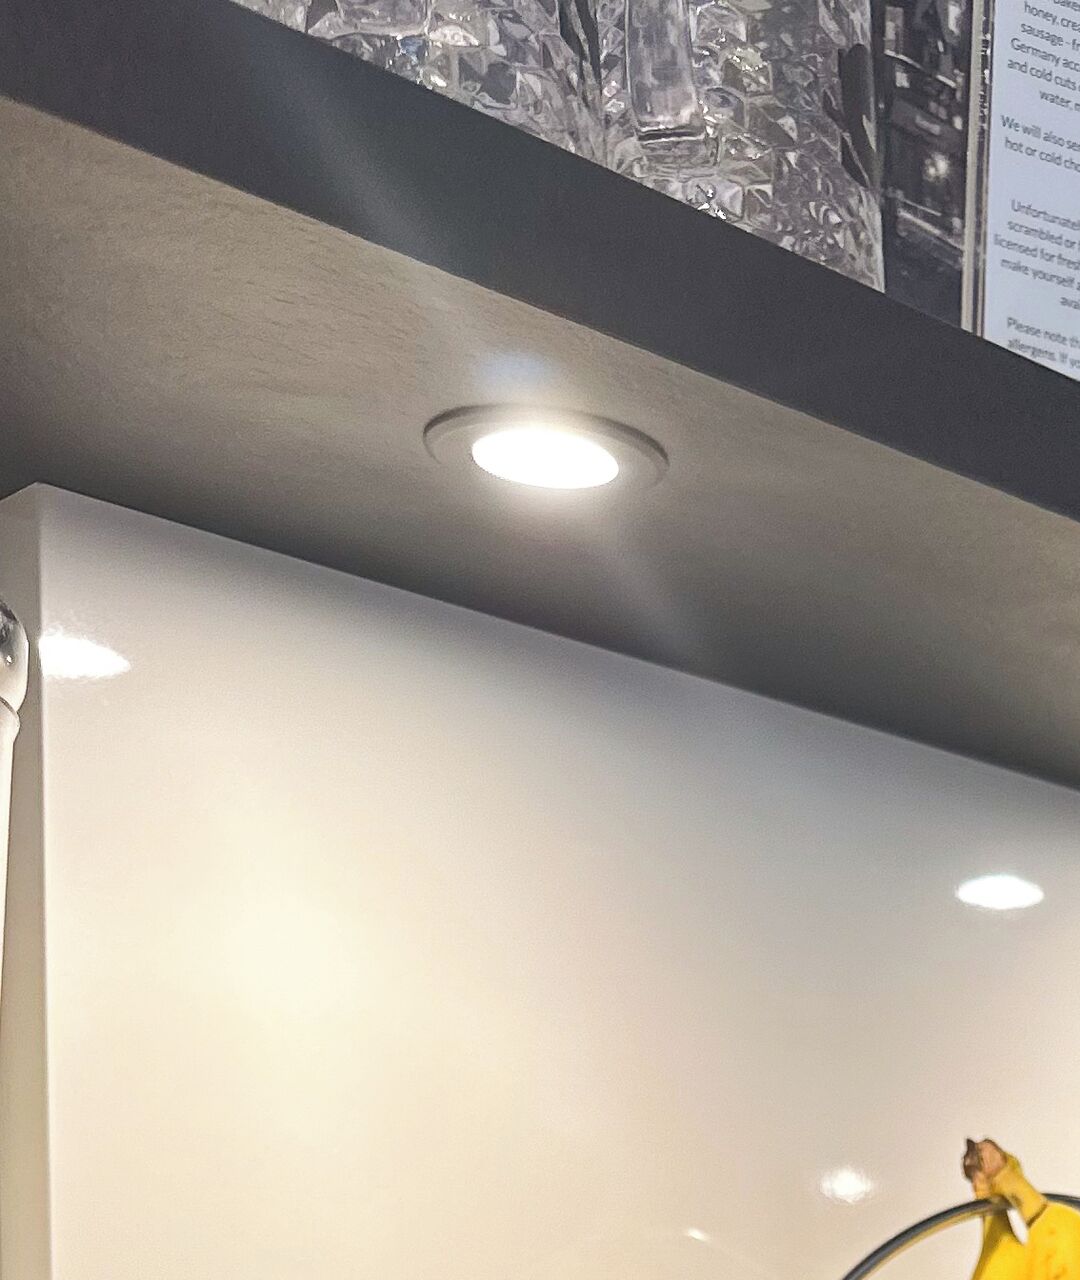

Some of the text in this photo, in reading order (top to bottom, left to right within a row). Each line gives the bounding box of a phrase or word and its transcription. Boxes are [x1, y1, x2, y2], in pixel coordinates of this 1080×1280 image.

[1024, 2, 1058, 27] honey,
[1021, 24, 1063, 47] sausage
[1011, 36, 1059, 68] Germany
[1007, 59, 1027, 74] and
[1029, 67, 1052, 82] cold
[1054, 75, 1076, 91] cuts
